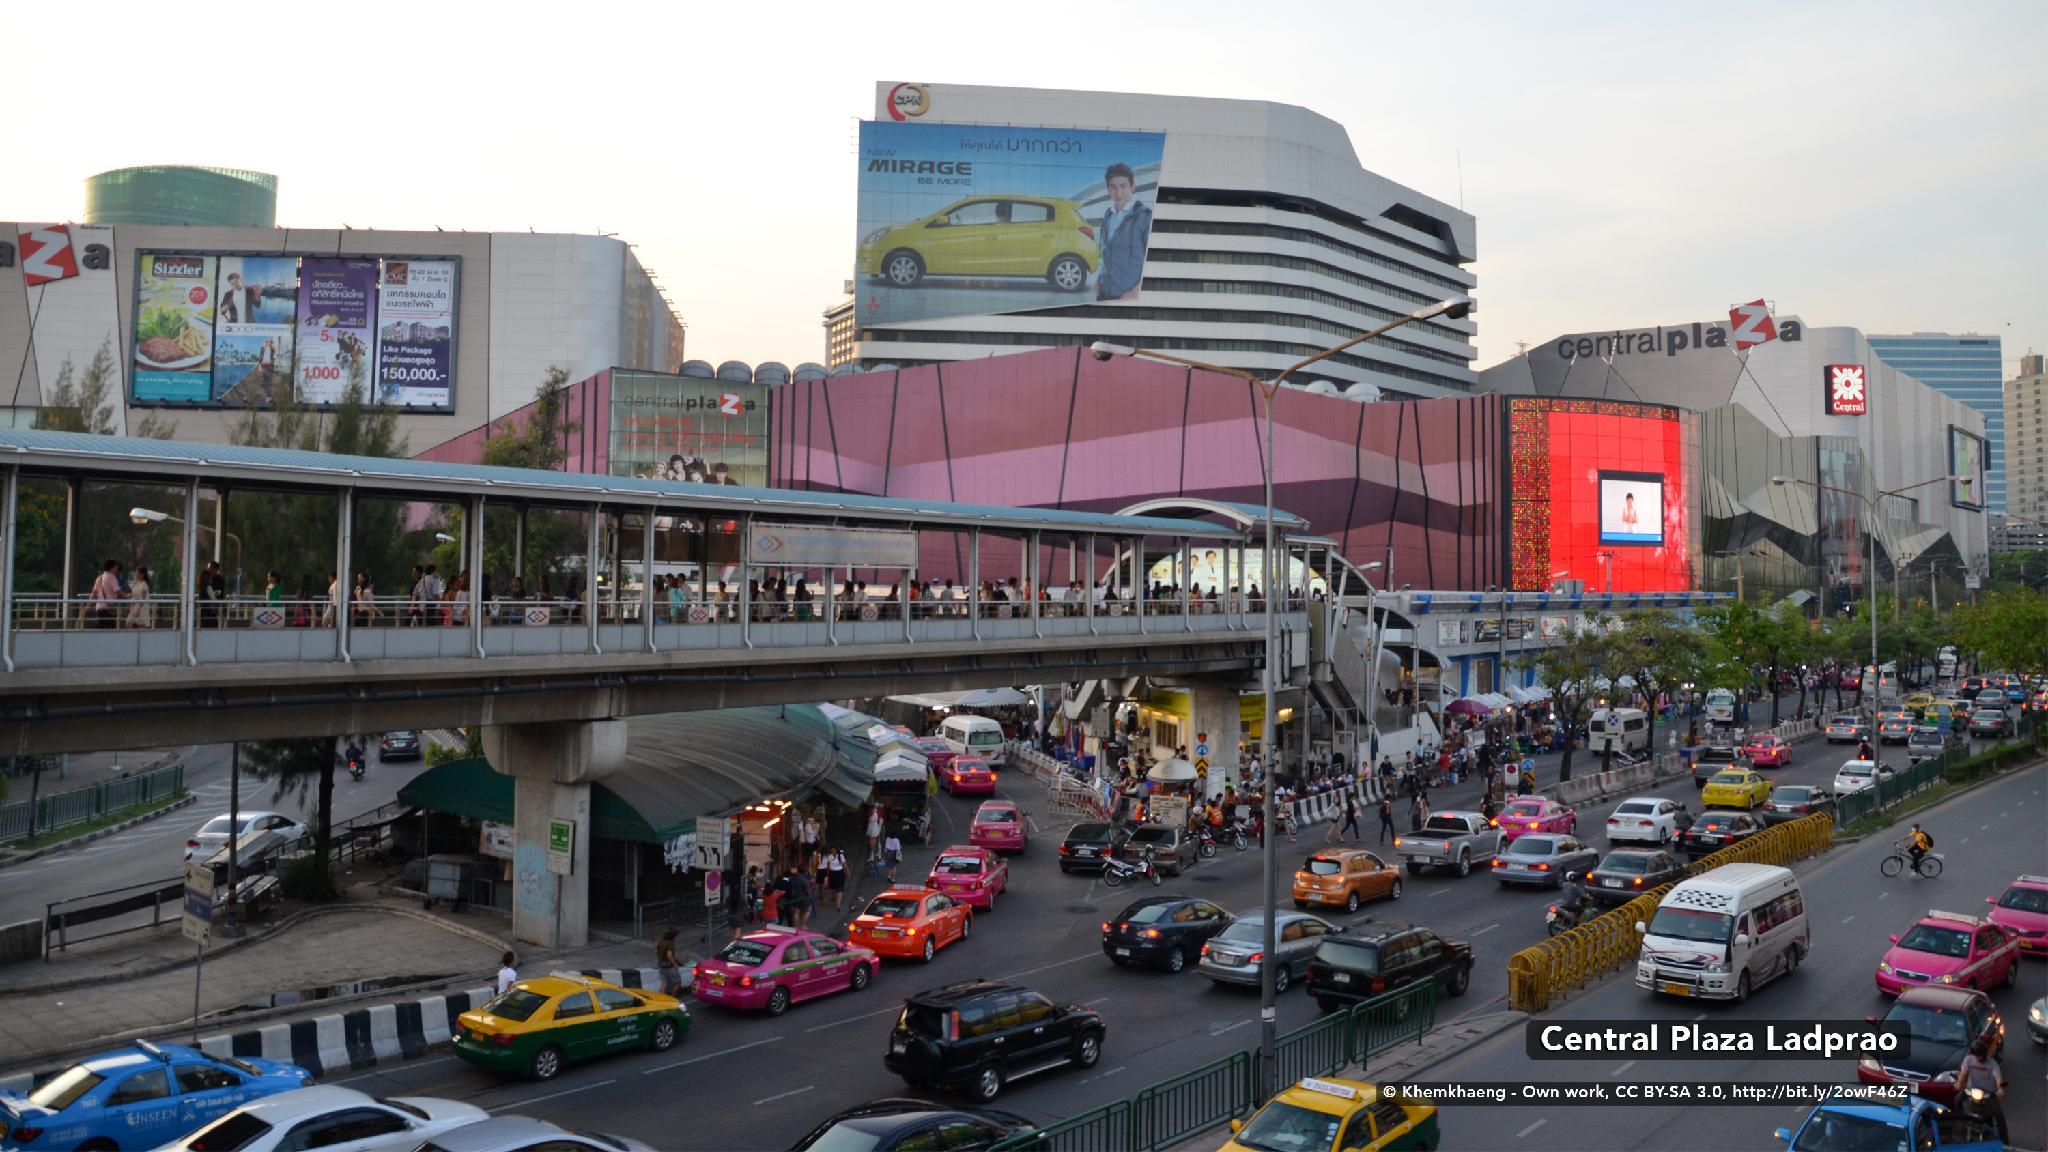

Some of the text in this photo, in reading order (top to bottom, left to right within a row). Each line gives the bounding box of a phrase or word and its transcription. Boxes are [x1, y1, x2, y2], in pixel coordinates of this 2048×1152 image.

[867, 159, 972, 175] MIRAGE
[917, 177, 972, 186] BE MORE
[153, 262, 202, 276] Sizzler
[383, 345, 432, 355] Like Package
[381, 367, 447, 382] 150,000.-
[1833, 401, 1864, 412] Central
